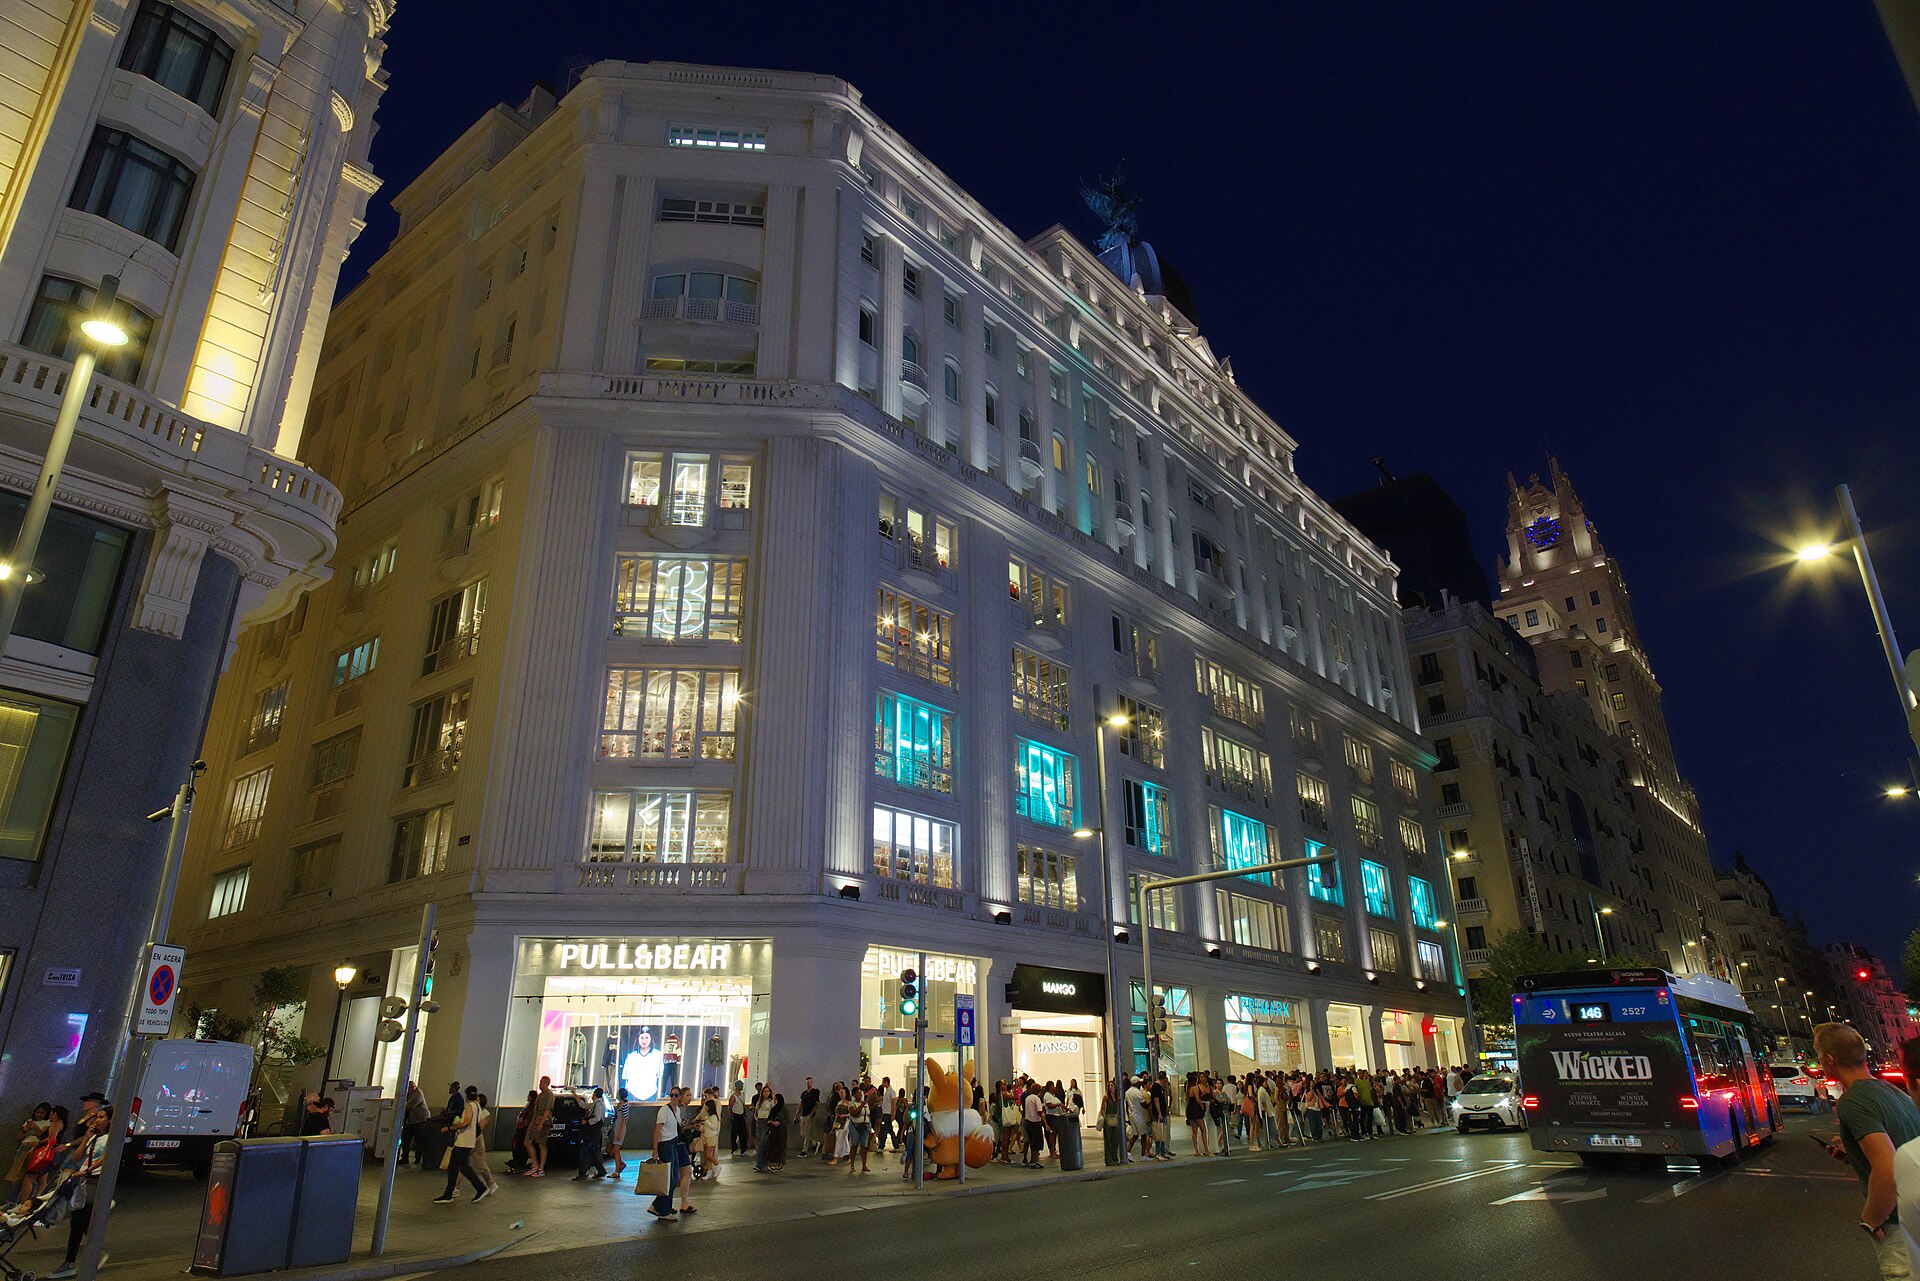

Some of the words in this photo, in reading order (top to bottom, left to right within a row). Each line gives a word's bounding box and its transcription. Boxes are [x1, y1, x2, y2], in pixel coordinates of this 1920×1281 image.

[1531, 892, 1540, 918] HOTEL
[153, 953, 162, 961] EN
[163, 954, 182, 963] ACERA
[560, 944, 728, 970] PULL&BEAR
[1042, 981, 1076, 995] MANGO
[145, 1007, 158, 1015] TODO
[1240, 996, 1291, 1018] PRIMARK
[1580, 1007, 1602, 1019] 146
[1621, 1007, 1646, 1016] 2527
[1033, 1041, 1078, 1053] MANGO
[1627, 1138, 1639, 1146] SP
